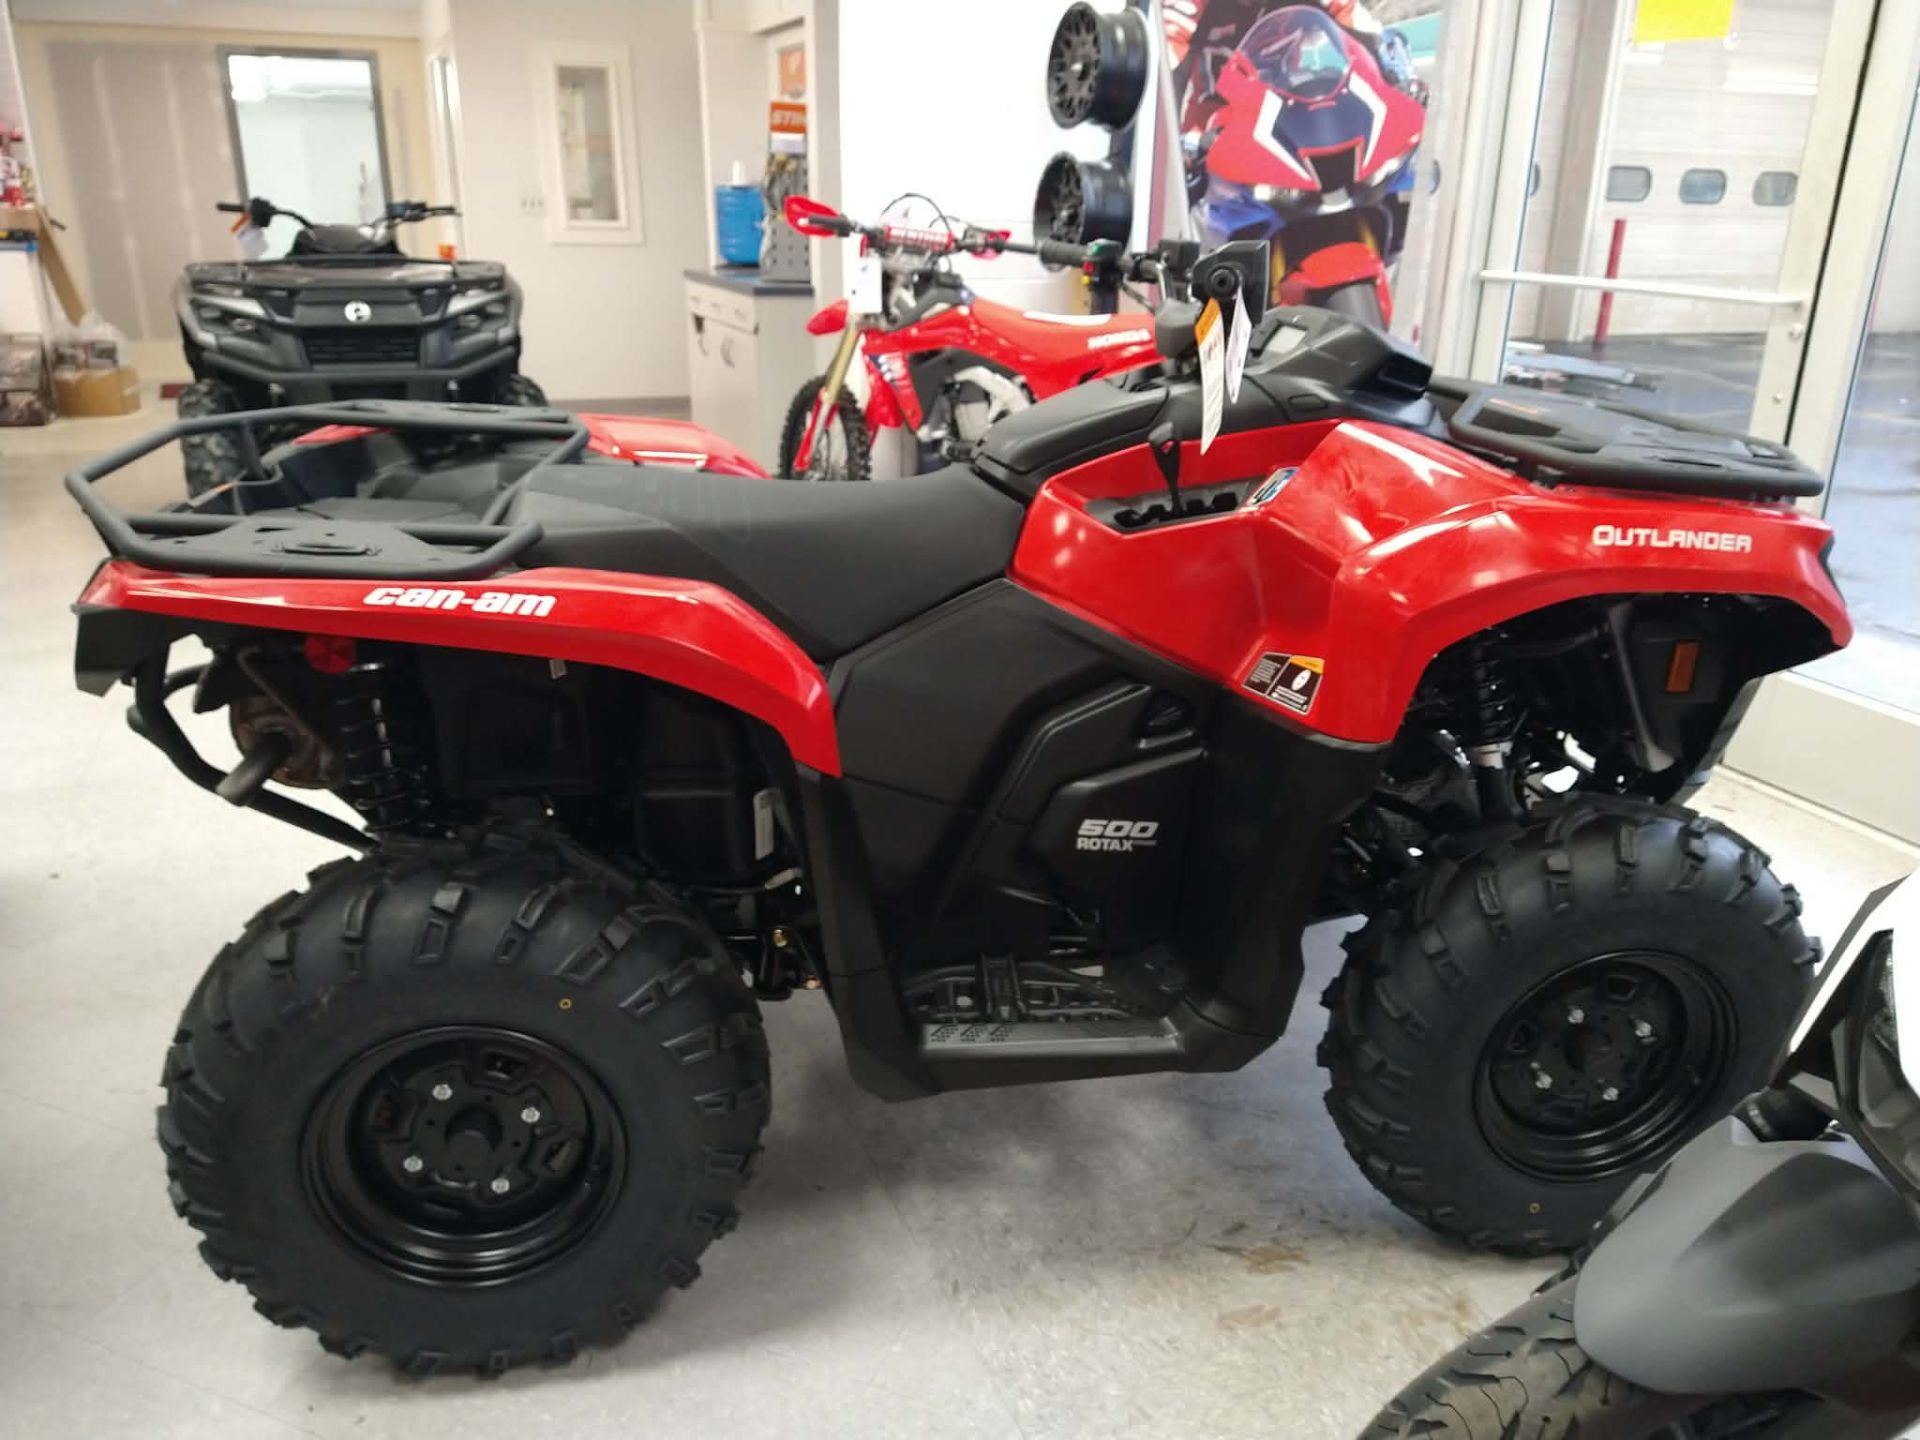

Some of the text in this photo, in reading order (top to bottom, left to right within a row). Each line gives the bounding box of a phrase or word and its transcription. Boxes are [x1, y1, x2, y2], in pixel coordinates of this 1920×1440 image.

[1087, 328, 1151, 351] HONDA
[1592, 524, 1753, 553] OUTLANDER
[363, 587, 557, 617] can-am
[1077, 818, 1159, 838] 500
[1076, 837, 1134, 852] ROTAX
